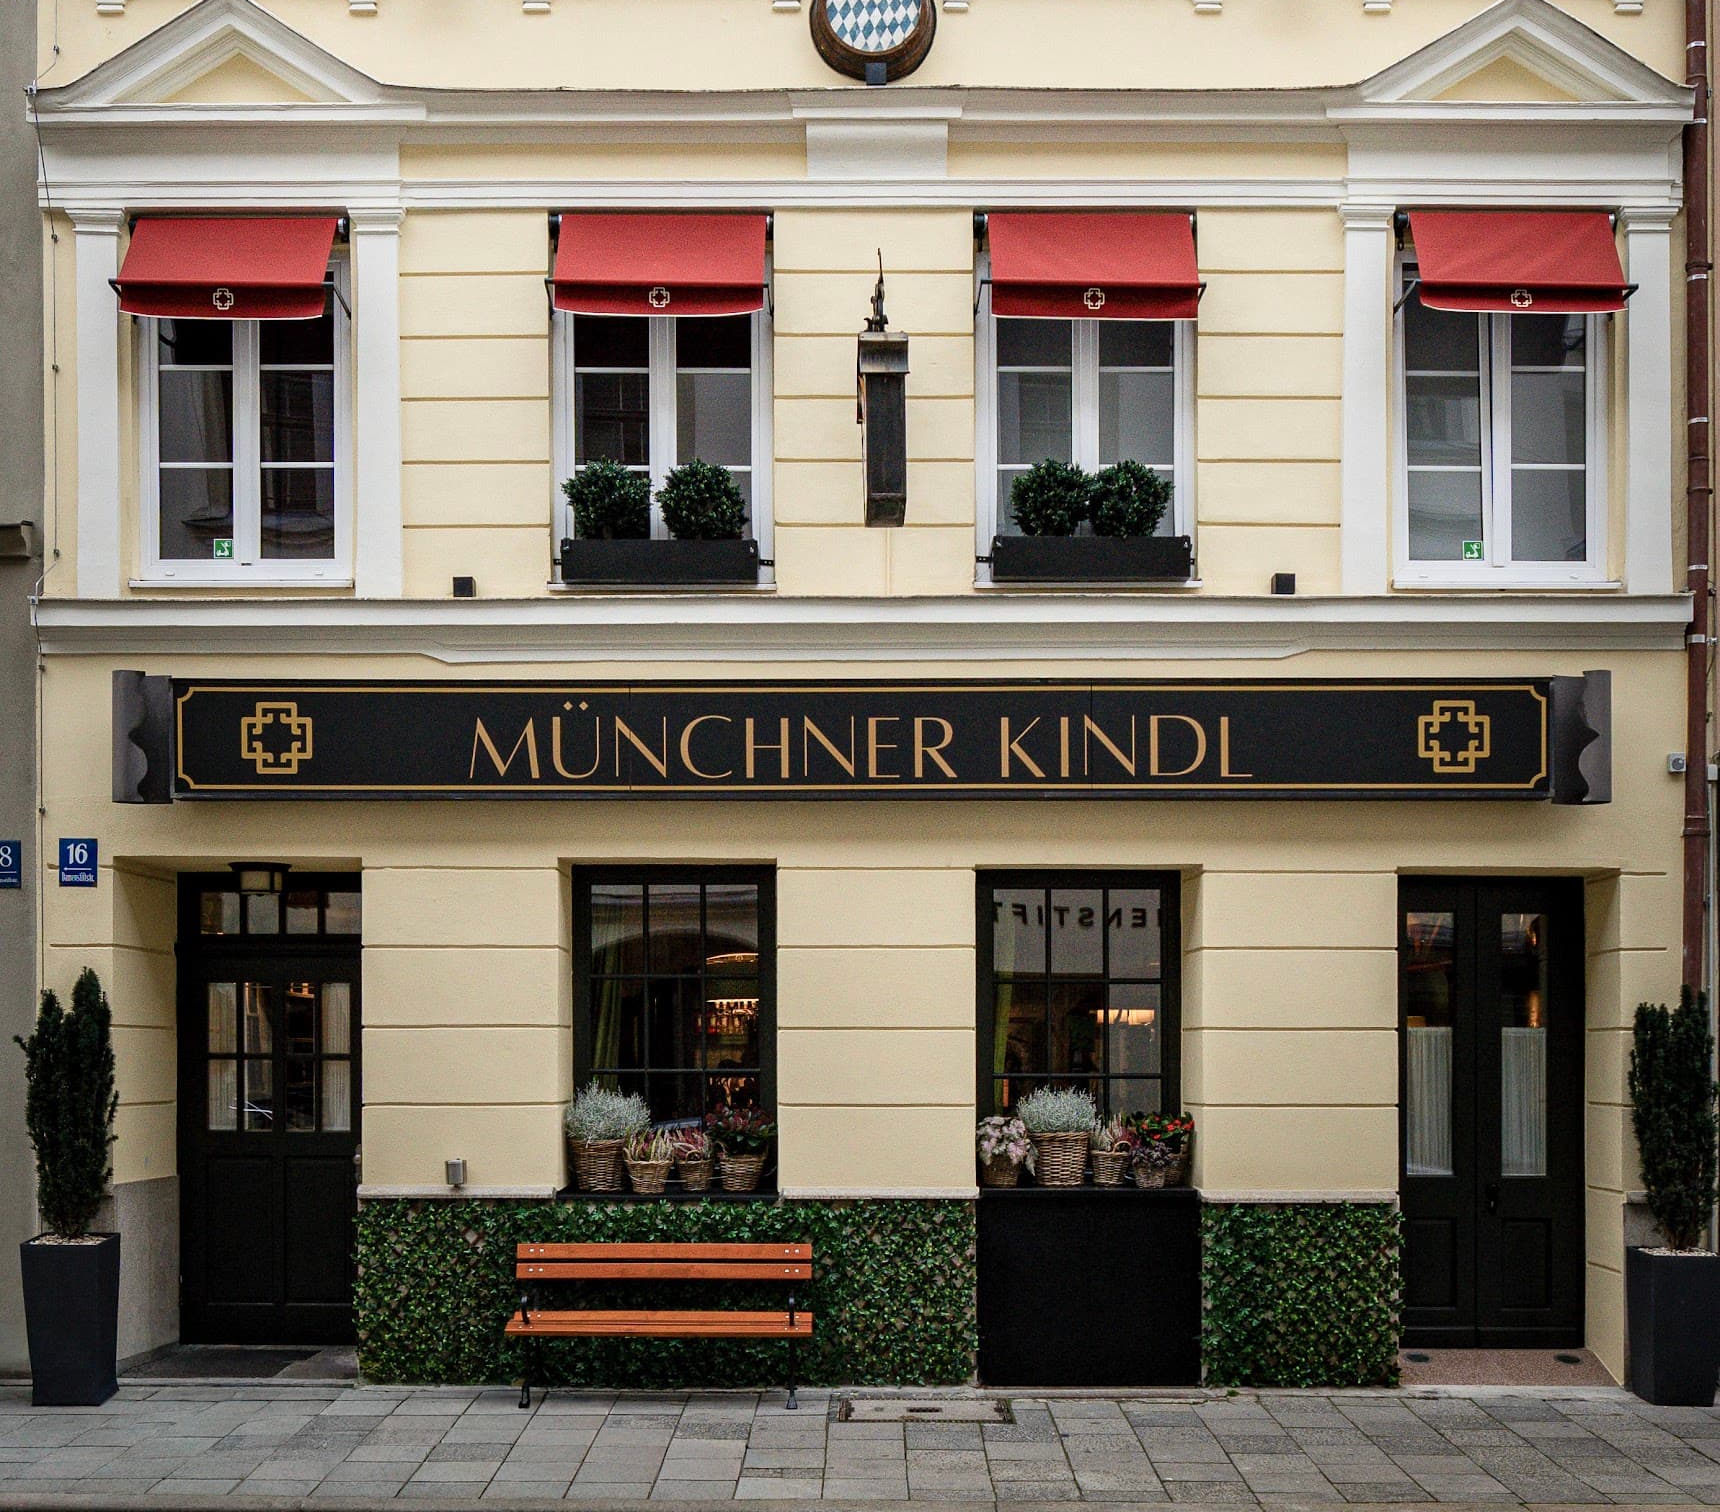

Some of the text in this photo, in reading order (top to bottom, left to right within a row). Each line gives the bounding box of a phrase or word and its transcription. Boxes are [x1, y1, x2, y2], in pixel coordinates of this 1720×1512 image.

[469, 700, 1253, 780] MÜNCHNER KINDL
[66, 843, 89, 865] 16
